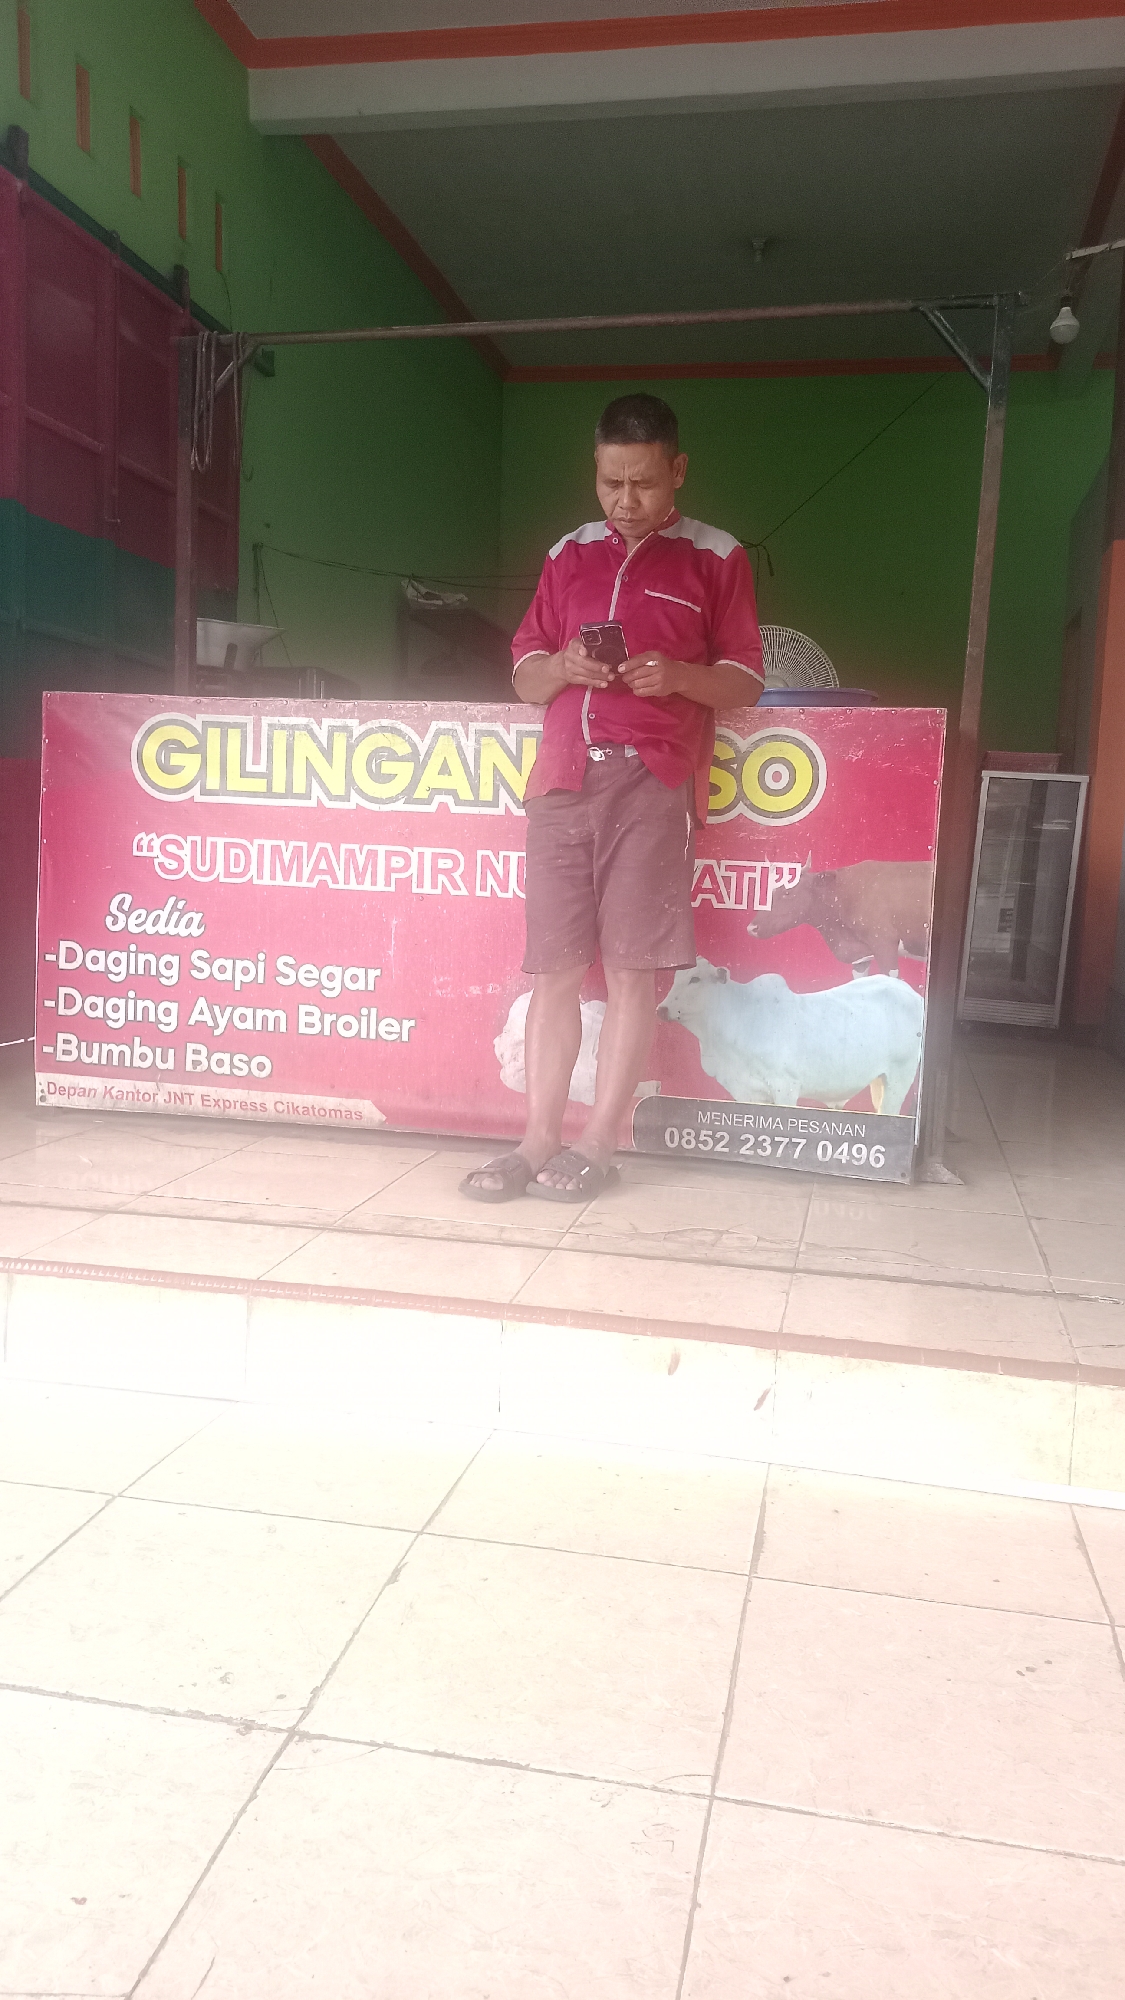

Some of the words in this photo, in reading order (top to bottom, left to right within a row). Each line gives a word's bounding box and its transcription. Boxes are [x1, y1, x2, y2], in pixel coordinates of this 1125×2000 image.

[131, 712, 543, 816] GILINGAN
[707, 726, 828, 827] SO
[105, 892, 206, 938] Sedia
[189, 948, 266, 992] Sapi
[275, 954, 382, 999] Segar
[187, 996, 288, 1037] Ayam
[297, 1004, 416, 1043] Broiler
[184, 1042, 273, 1079] Baso
[46, 1081, 97, 1098] Depan
[103, 1085, 158, 1103] Kantor
[163, 1091, 195, 1106] JNT
[201, 1094, 268, 1114] Express
[274, 1100, 364, 1121] Cikatomas
[697, 1110, 784, 1131] MENERIMA
[787, 1118, 866, 1138] PESANAN
[664, 1127, 730, 1153] 0852
[739, 1133, 808, 1160] 2377
[816, 1140, 886, 1169] 0496
